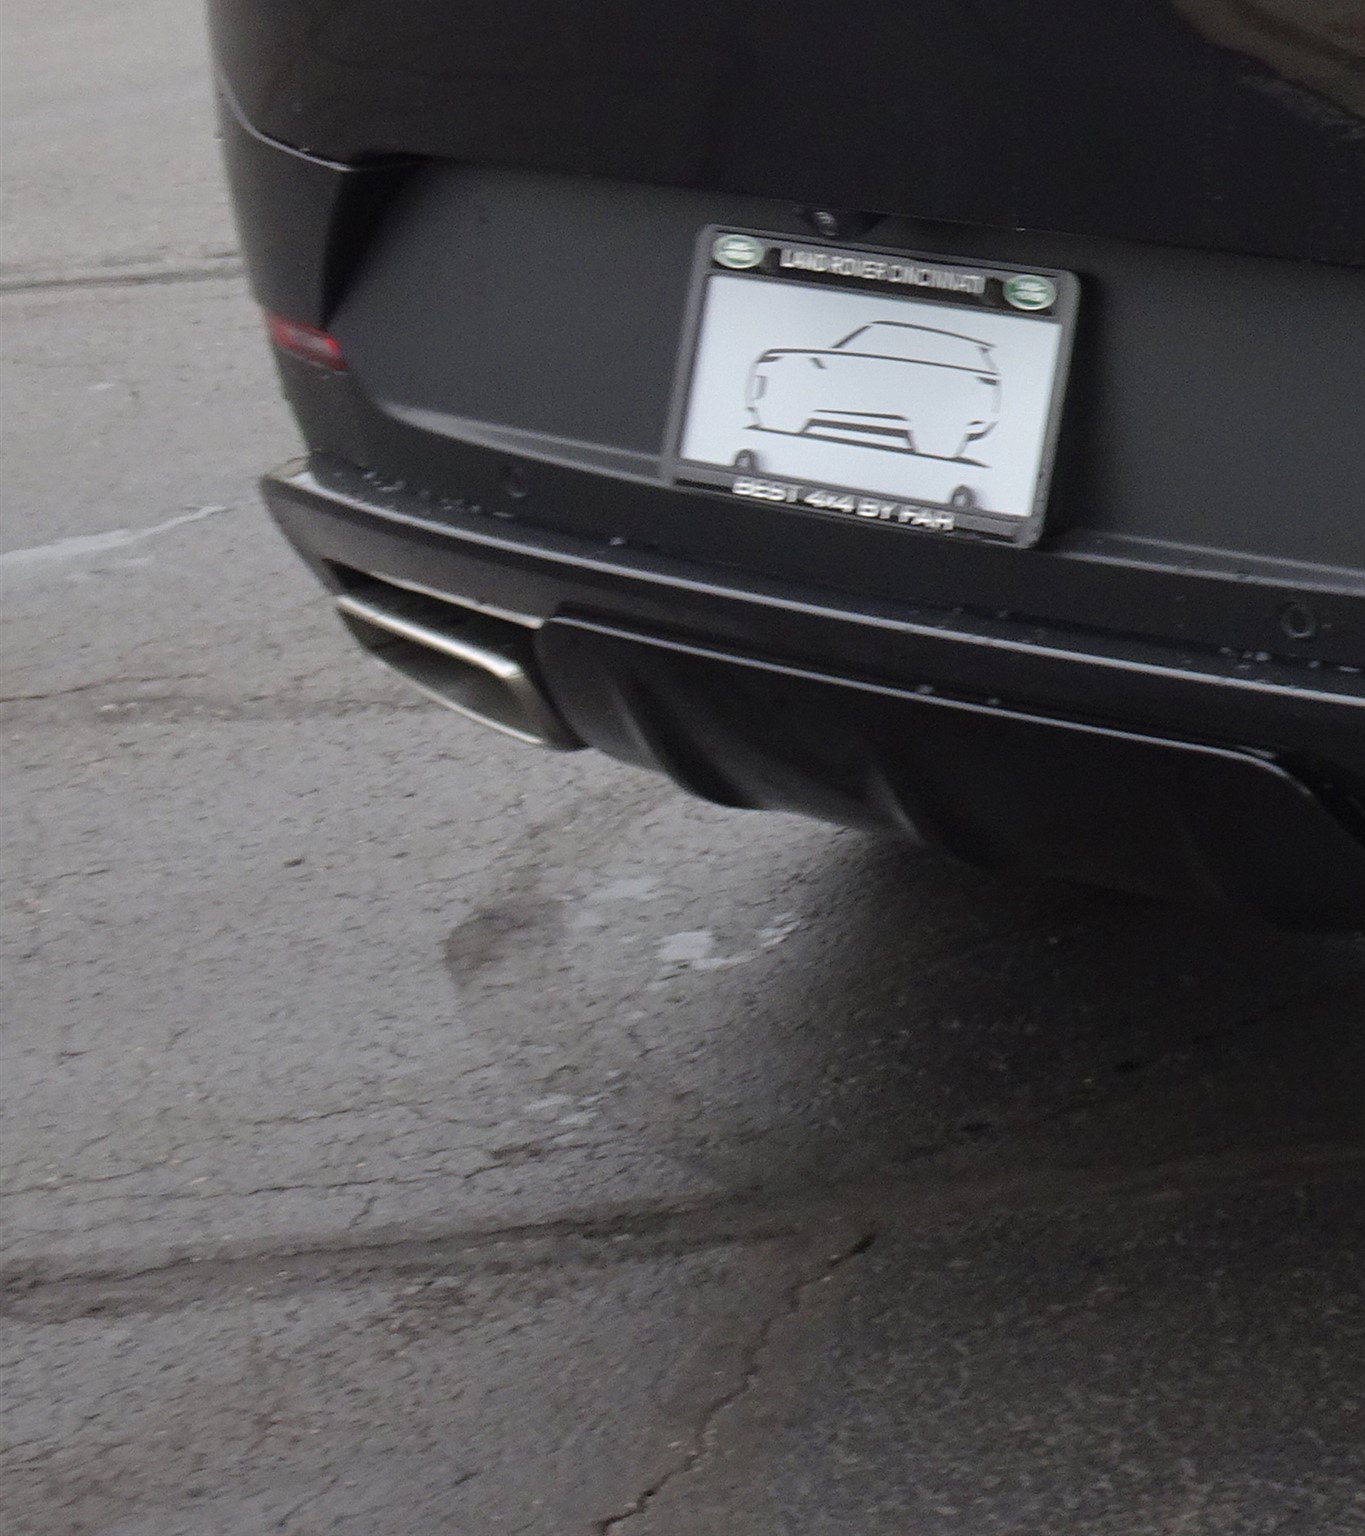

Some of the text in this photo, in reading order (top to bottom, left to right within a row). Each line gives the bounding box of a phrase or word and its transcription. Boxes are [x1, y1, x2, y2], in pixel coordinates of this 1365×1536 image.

[829, 255, 887, 280] ROVER
[732, 477, 800, 503] BEST
[856, 498, 897, 520] BY
[897, 505, 955, 531] FAR
